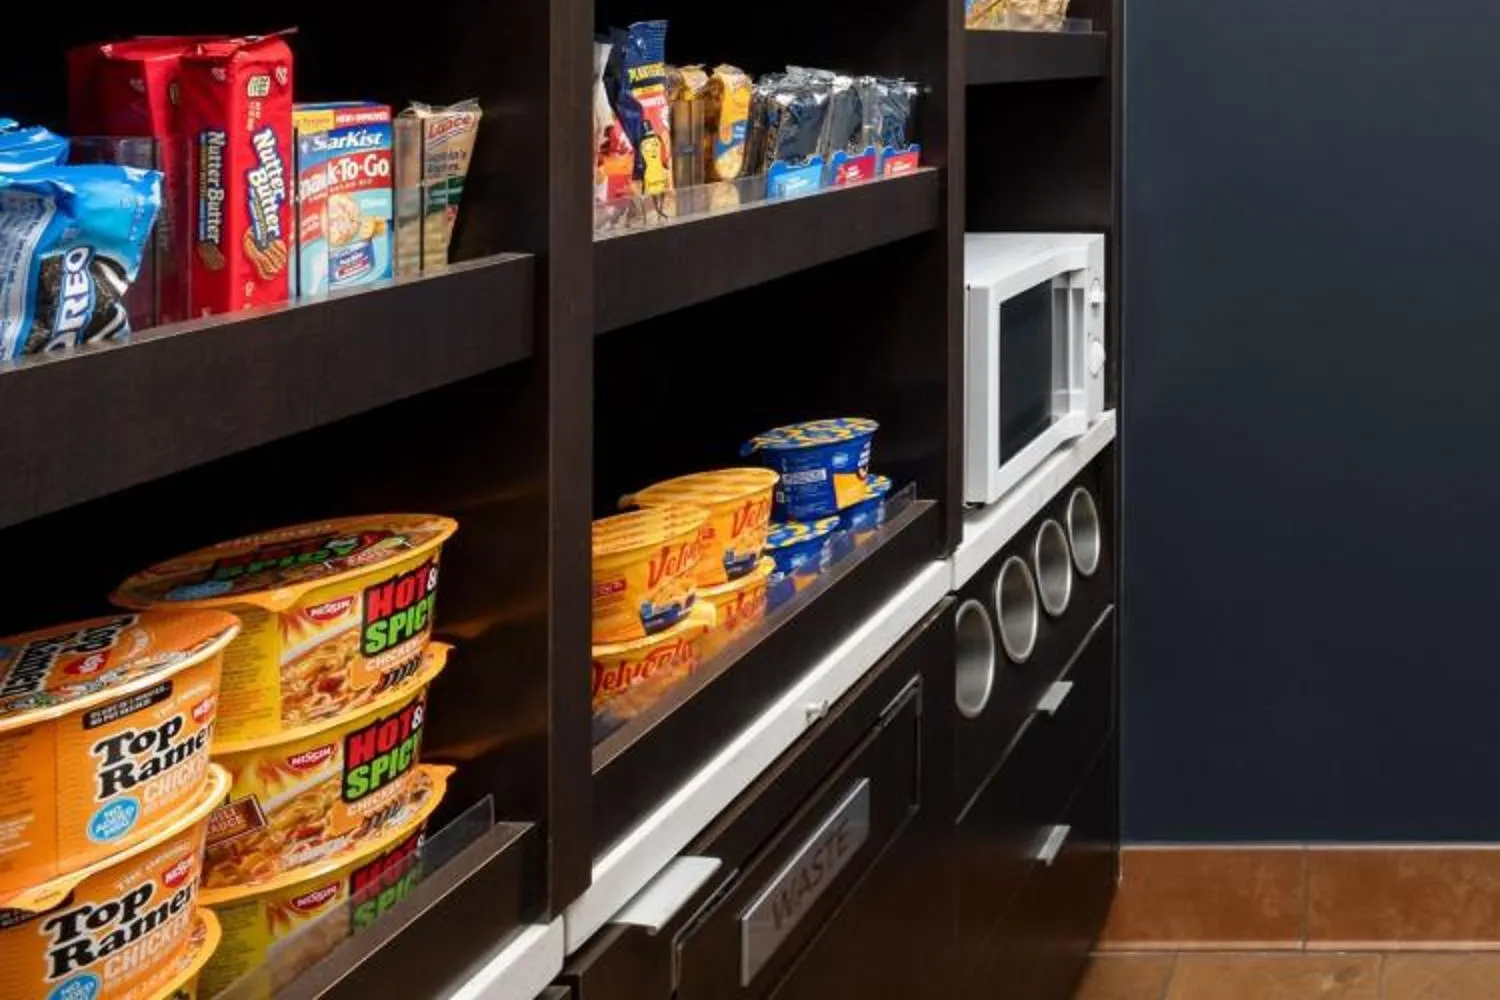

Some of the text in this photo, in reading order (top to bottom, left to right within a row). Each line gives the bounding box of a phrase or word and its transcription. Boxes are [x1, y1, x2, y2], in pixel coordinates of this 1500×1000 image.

[207, 131, 226, 245] Nutter Butter
[252, 127, 286, 201] Nutter
[249, 168, 281, 238] Butter
[367, 565, 428, 624] HOT
[93, 715, 183, 767] Top
[349, 706, 413, 768] HOT
[771, 818, 852, 931] WASTE
[44, 882, 154, 945] Top
